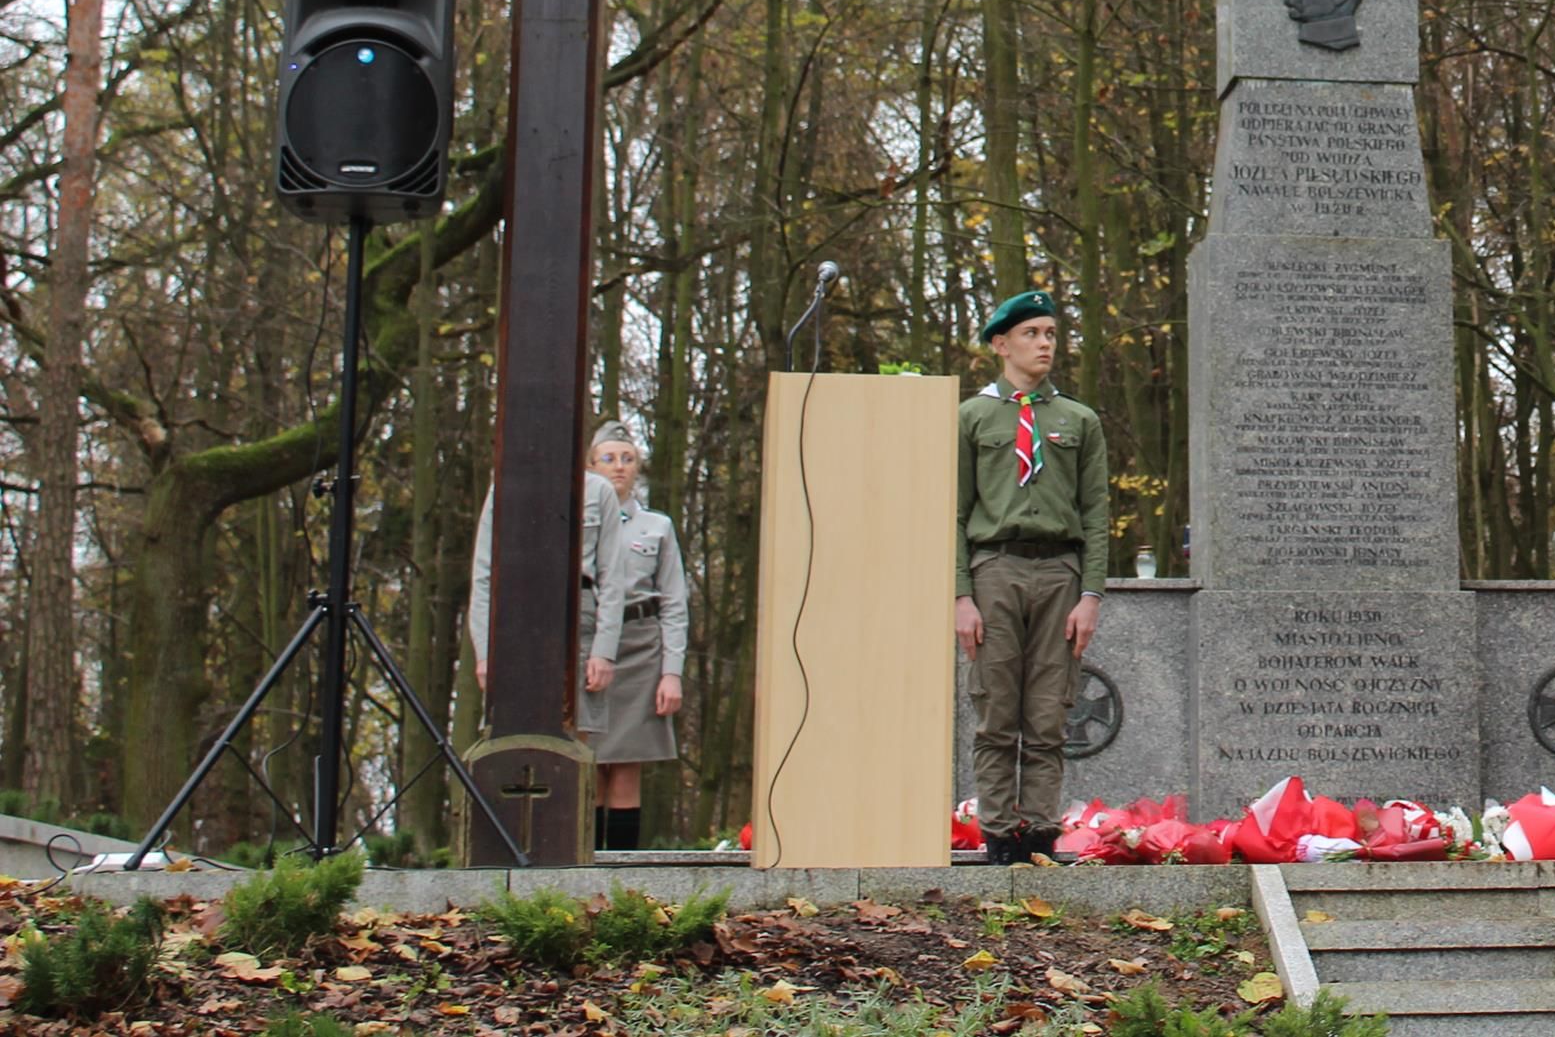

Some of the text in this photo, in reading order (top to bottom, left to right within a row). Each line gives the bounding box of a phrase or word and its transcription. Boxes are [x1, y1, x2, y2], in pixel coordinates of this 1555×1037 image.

[1294, 609, 1344, 624] ROKU
[1274, 631, 1342, 646] MIASTO
[1257, 654, 1363, 670] BOHATEROM
[1233, 677, 1248, 693] O
[1238, 700, 1255, 716] W
[1296, 723, 1383, 739] ODPARCIA
[1217, 745, 1462, 763] NAJAZDU BOLSZEWICKIEGO
